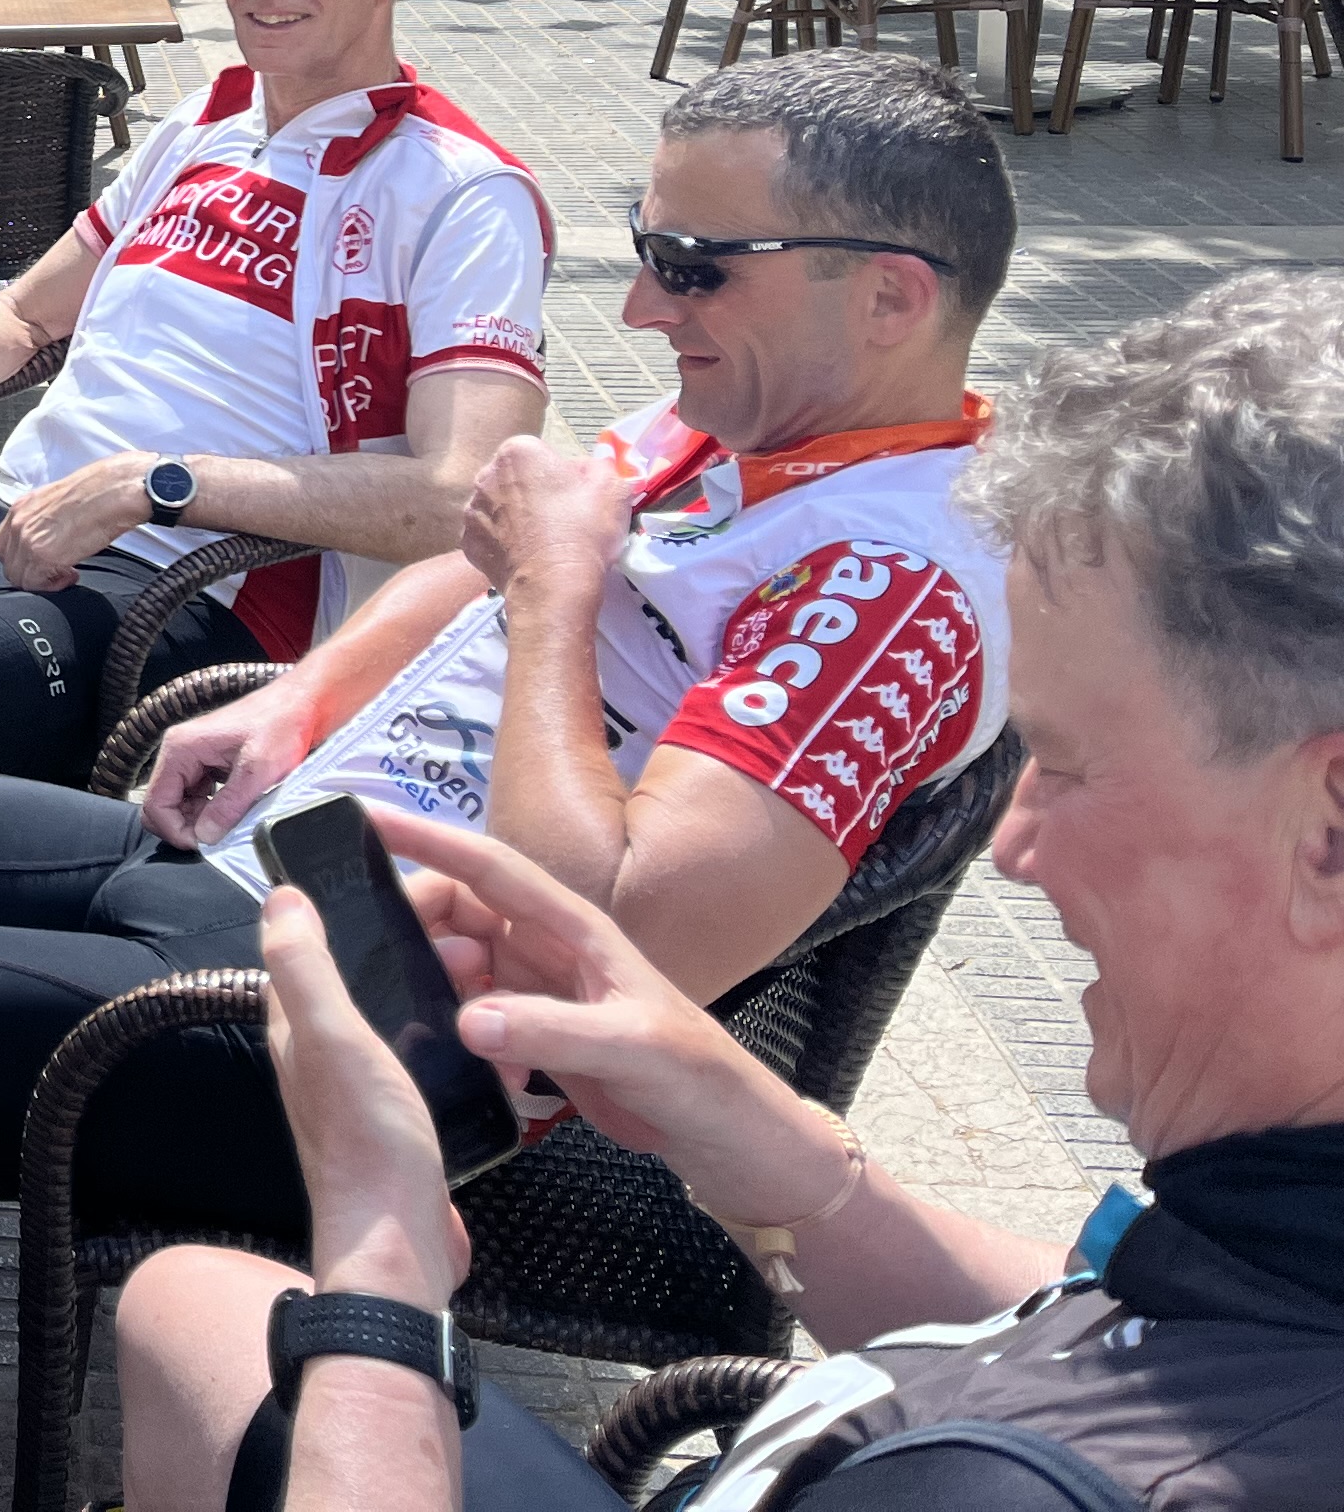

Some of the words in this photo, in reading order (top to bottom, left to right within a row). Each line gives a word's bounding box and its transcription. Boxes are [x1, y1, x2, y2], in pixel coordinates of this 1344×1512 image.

[752, 241, 783, 251] uvex
[18, 618, 66, 697] GORE
[387, 712, 484, 822] Garden
